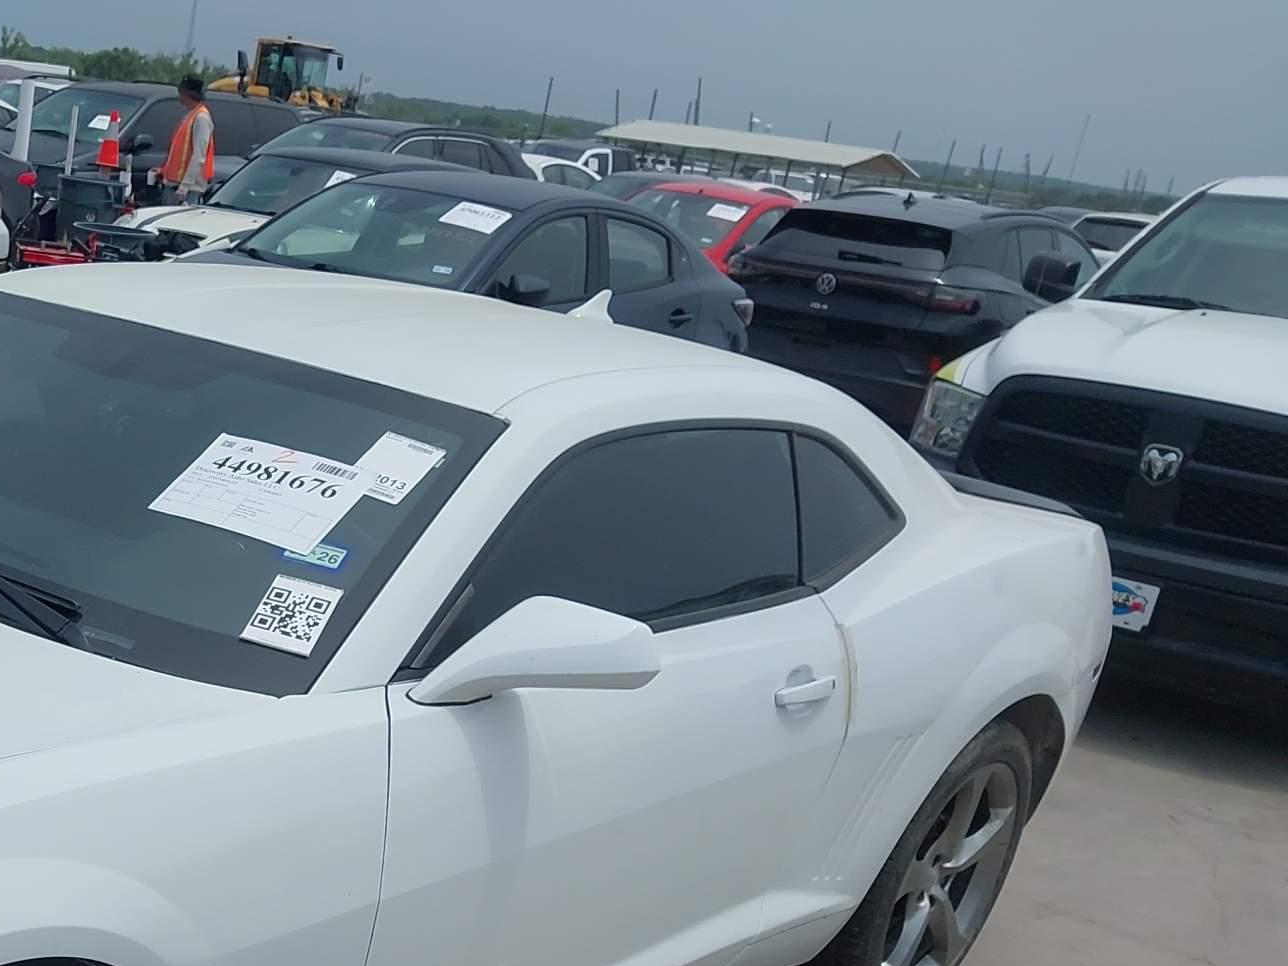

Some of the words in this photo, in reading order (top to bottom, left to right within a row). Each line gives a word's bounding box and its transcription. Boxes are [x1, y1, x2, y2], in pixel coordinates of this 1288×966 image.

[271, 450, 298, 464] 2
[212, 456, 344, 499] 44981676
[316, 551, 340, 565] 26
